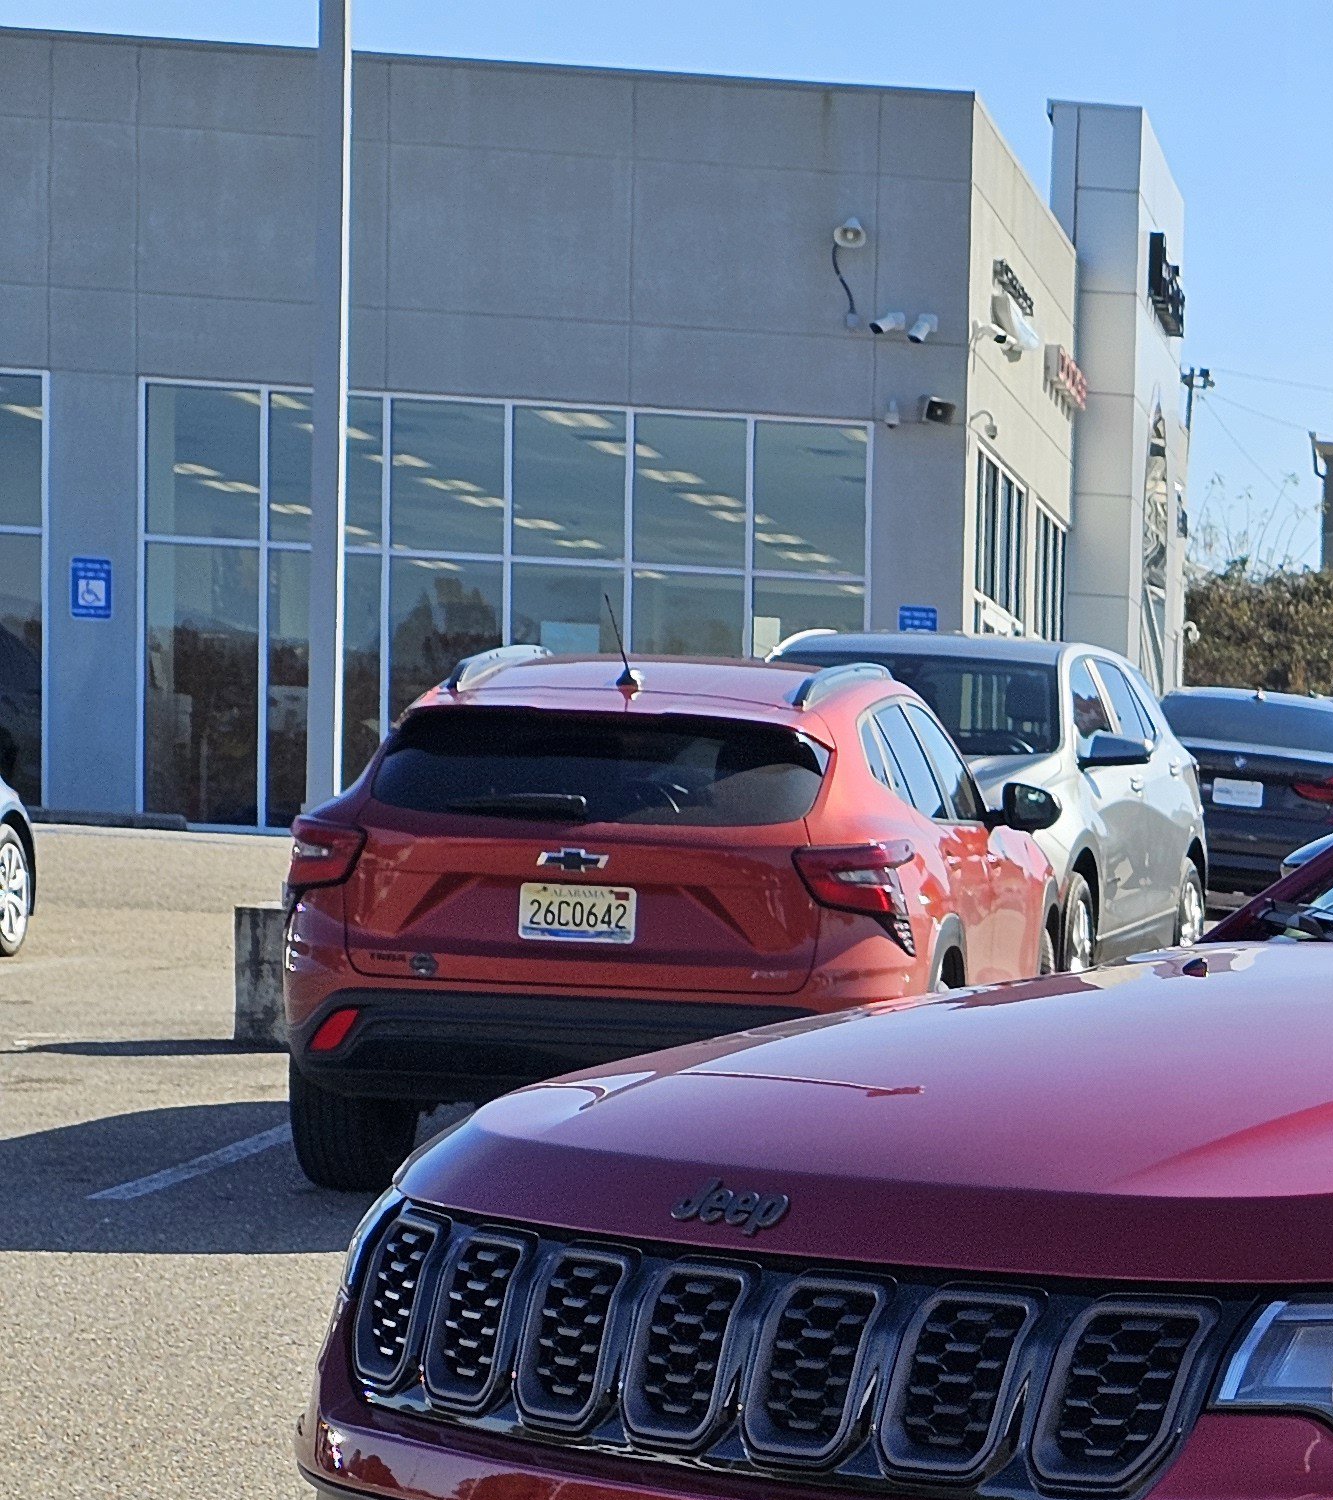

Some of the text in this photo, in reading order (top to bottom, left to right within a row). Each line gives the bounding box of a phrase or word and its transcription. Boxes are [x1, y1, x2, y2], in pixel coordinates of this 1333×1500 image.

[550, 888, 606, 899] ALABAMA
[529, 899, 628, 930] 26C0642
[670, 1176, 789, 1236] Jeep
